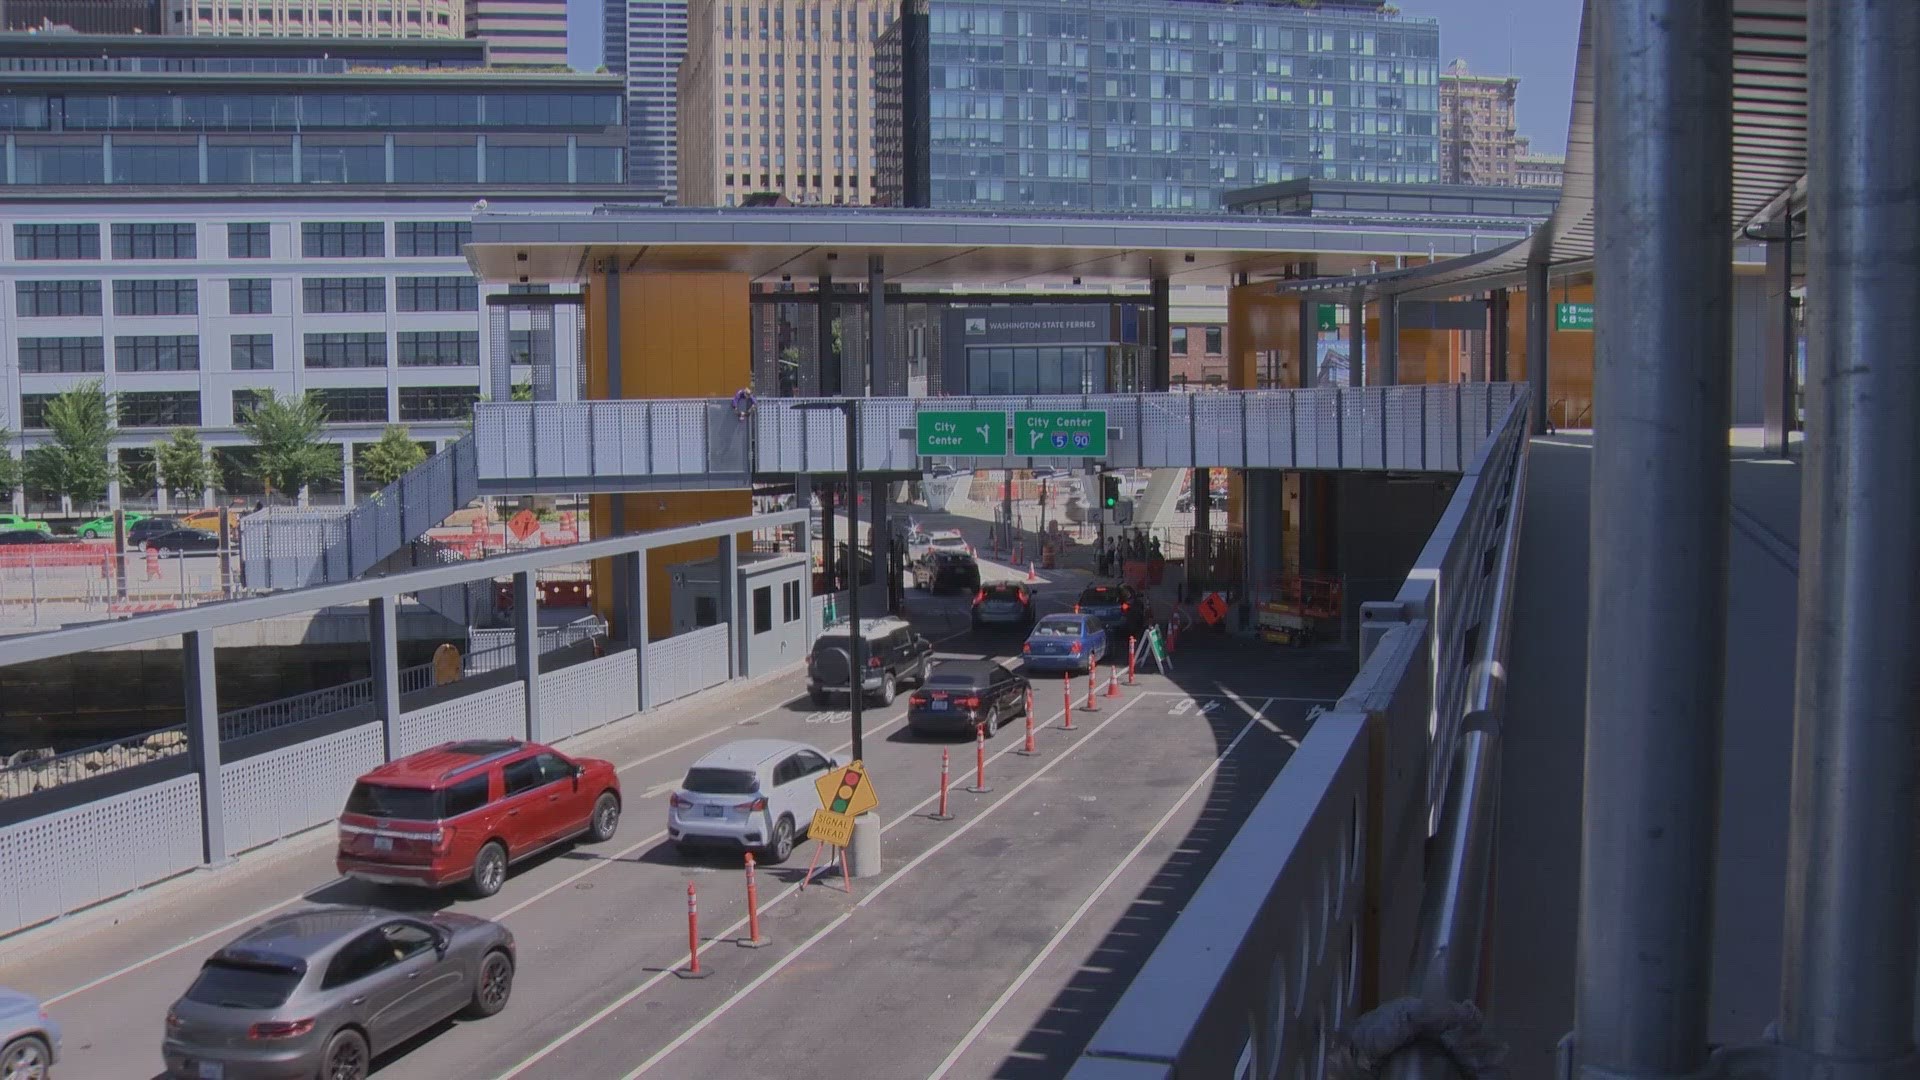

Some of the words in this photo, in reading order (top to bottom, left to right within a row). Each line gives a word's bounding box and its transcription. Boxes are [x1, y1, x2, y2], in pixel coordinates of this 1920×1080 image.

[989, 321, 1041, 330] WASHINGTON
[1042, 321, 1064, 329] STATE
[1066, 320, 1096, 329] FERRIES
[934, 422, 956, 433] City
[1027, 417, 1049, 428] City
[1056, 417, 1093, 428] Center
[928, 436, 963, 446] Center
[1056, 436, 1065, 448] 5
[1074, 436, 1088, 447] 90
[818, 814, 847, 829] SIGNAL
[814, 826, 844, 839] AHEAD
